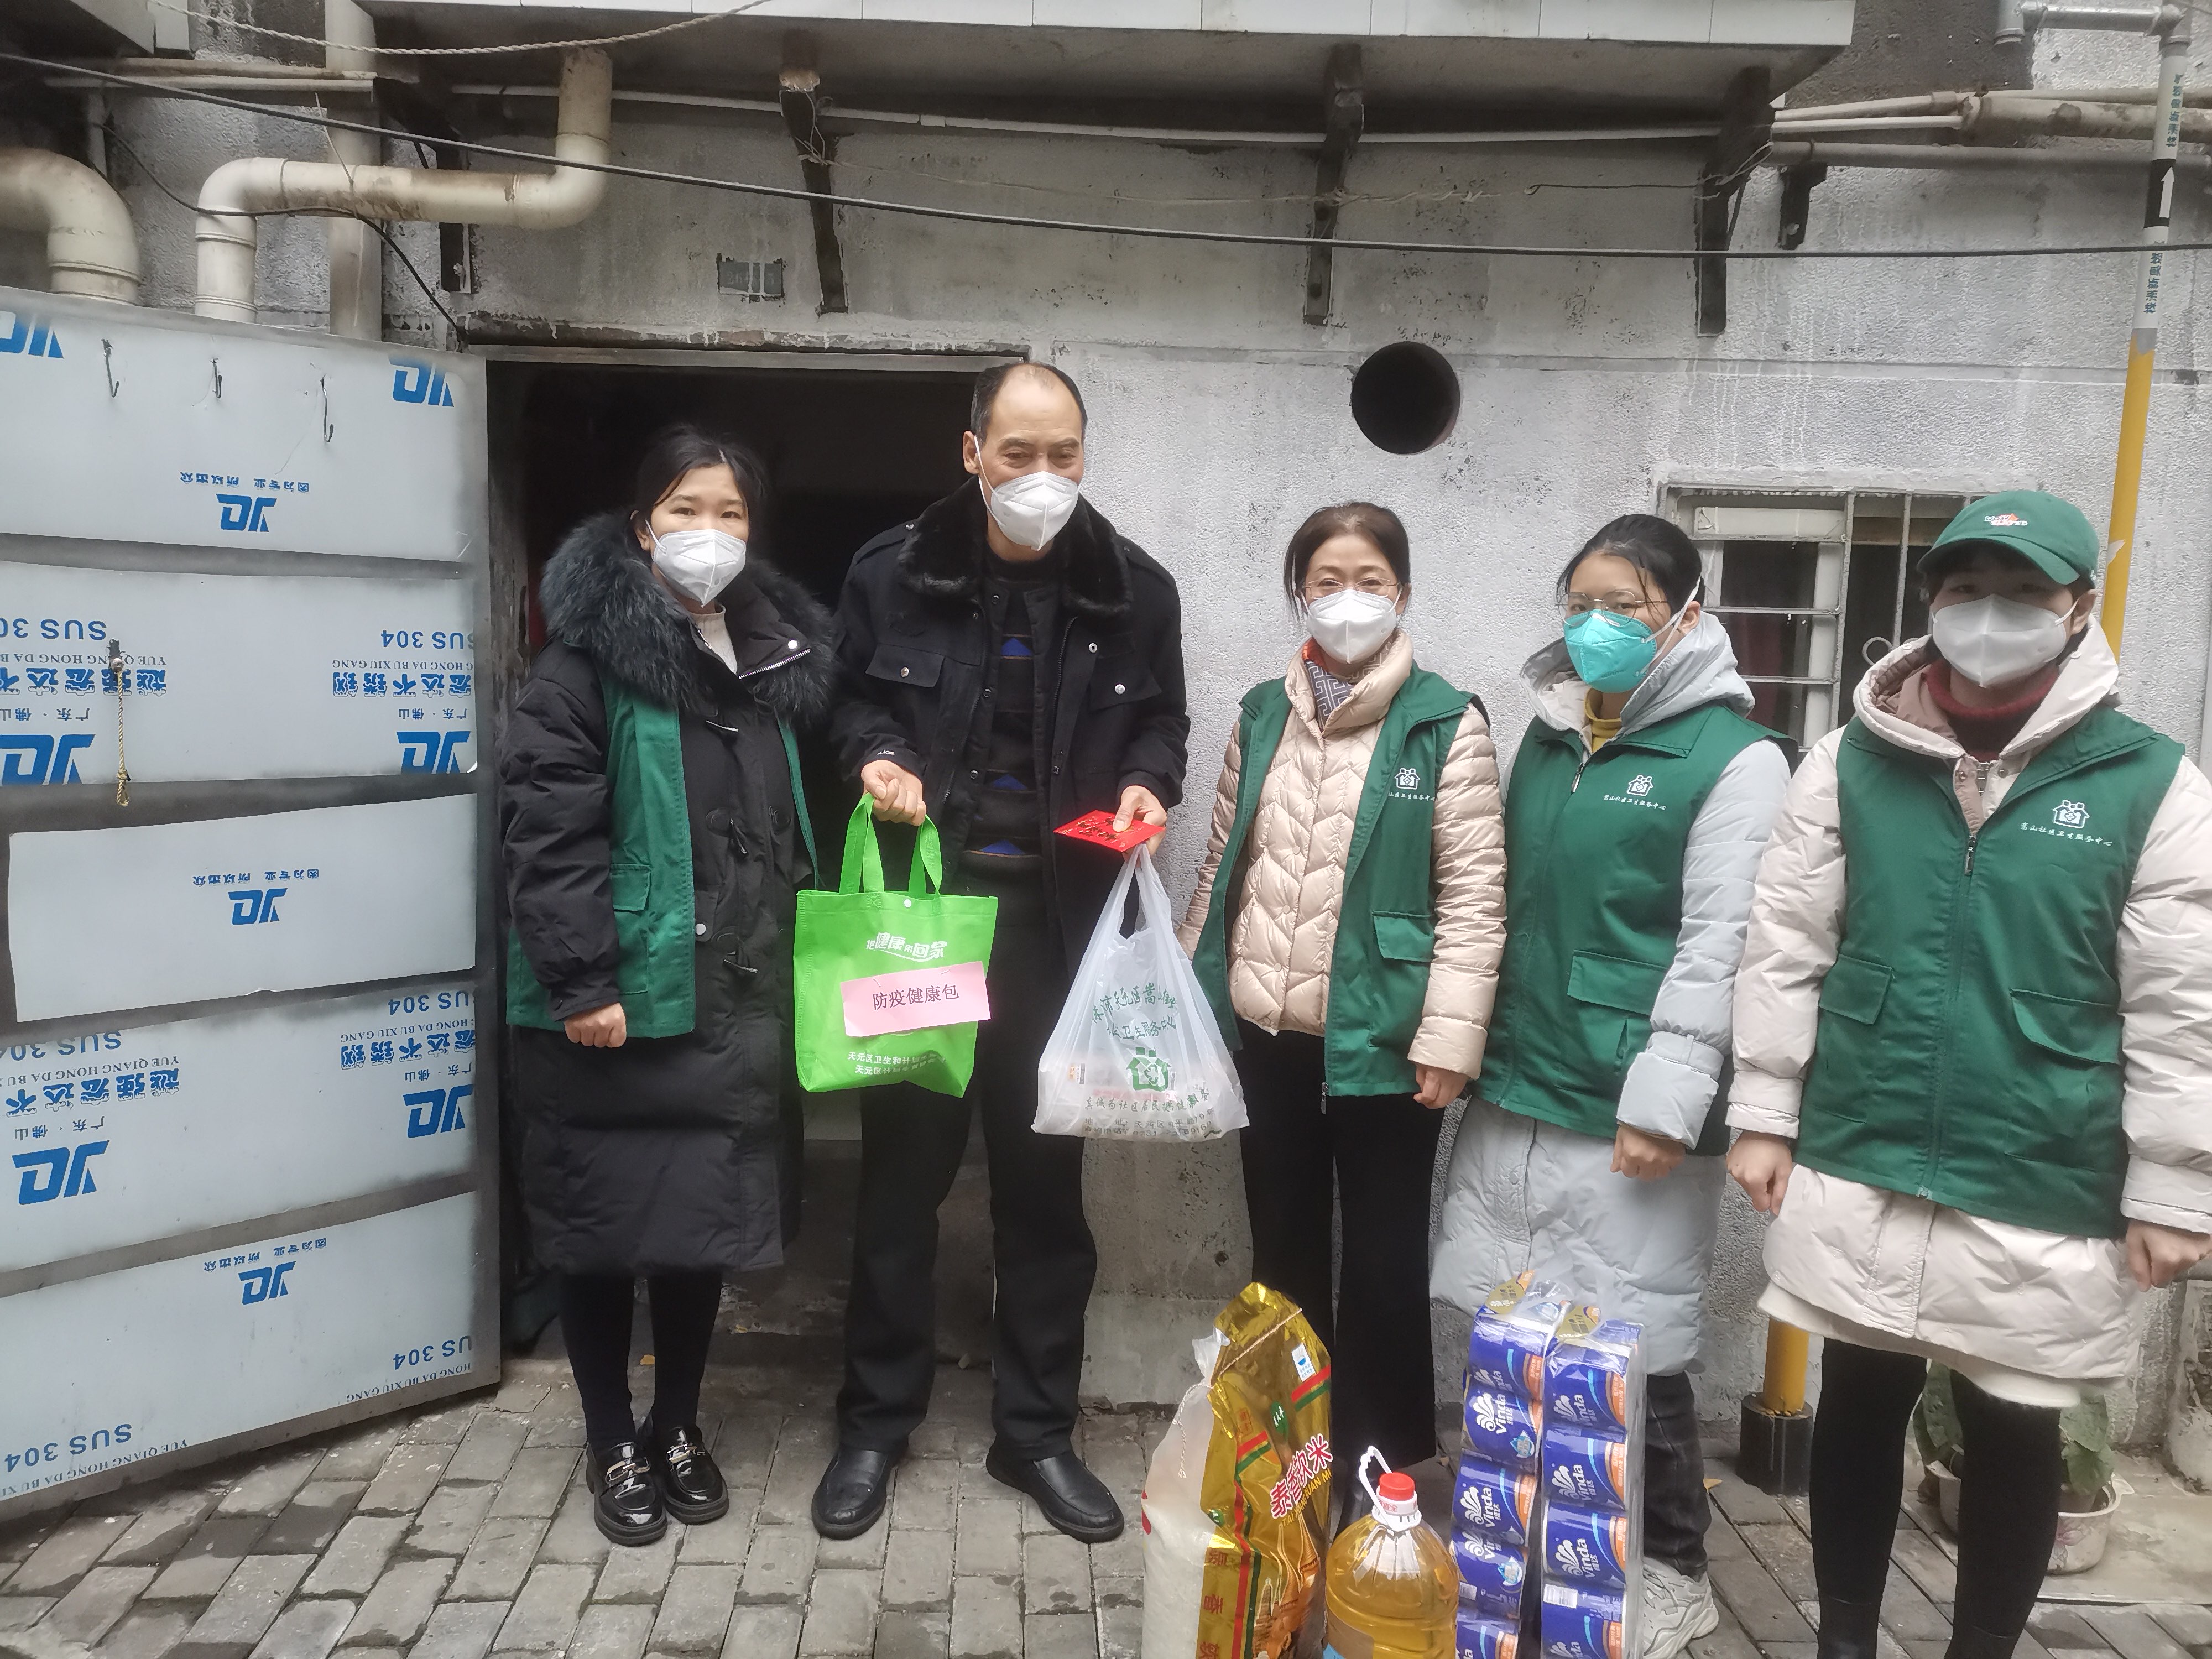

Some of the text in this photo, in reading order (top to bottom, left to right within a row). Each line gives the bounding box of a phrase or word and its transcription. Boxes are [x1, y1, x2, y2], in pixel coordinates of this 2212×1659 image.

[180, 472, 309, 494] 因为专业 所以出众
[40, 619, 107, 641] SUS
[380, 630, 423, 648] 304
[13, 653, 34, 663] DA
[39, 654, 82, 664] HONG
[87, 655, 134, 665] QNG
[138, 656, 166, 665] YUE
[332, 660, 367, 668] GANG
[369, 660, 390, 669] XIU
[394, 661, 409, 669] BU
[430, 661, 462, 670] HONG
[333, 672, 472, 698] 宏达不锈钢
[2020, 822, 2112, 847] 嵩山社区卫生服务中心
[192, 869, 319, 888] 因为专业 所以出众
[866, 932, 947, 958] 把健康带回家
[388, 995, 429, 1015] 304
[873, 984, 959, 1010] 防疫健康包
[340, 1019, 468, 1042] HONG DA BU XIU GANG
[57, 1030, 121, 1056] SUS
[341, 1030, 475, 1070] 宏达不锈钢
[7, 1056, 179, 1086] YUE QIANG HONG DA BU
[204, 1238, 326, 1273] 因为专业 所以出众
[393, 1345, 434, 1370] 304
[346, 1362, 471, 1402] HONG DA BU XIU GANG
[1495, 1394, 1507, 1434] Vinda
[4, 1423, 132, 1473] SUS 304
[161, 1439, 188, 1452] YUE
[113, 1447, 158, 1467] QIANG
[44, 1473, 62, 1484] DA
[67, 1460, 108, 1479] HONG
[1270, 1433, 1333, 1519] 泰香软米
[1321, 1468, 1332, 1483] MI
[20, 1479, 40, 1493] BU
[1572, 1464, 1592, 1501] Vinda
[1481, 1487, 1495, 1528] Vinda
[1577, 1538, 1596, 1578] Vinda
